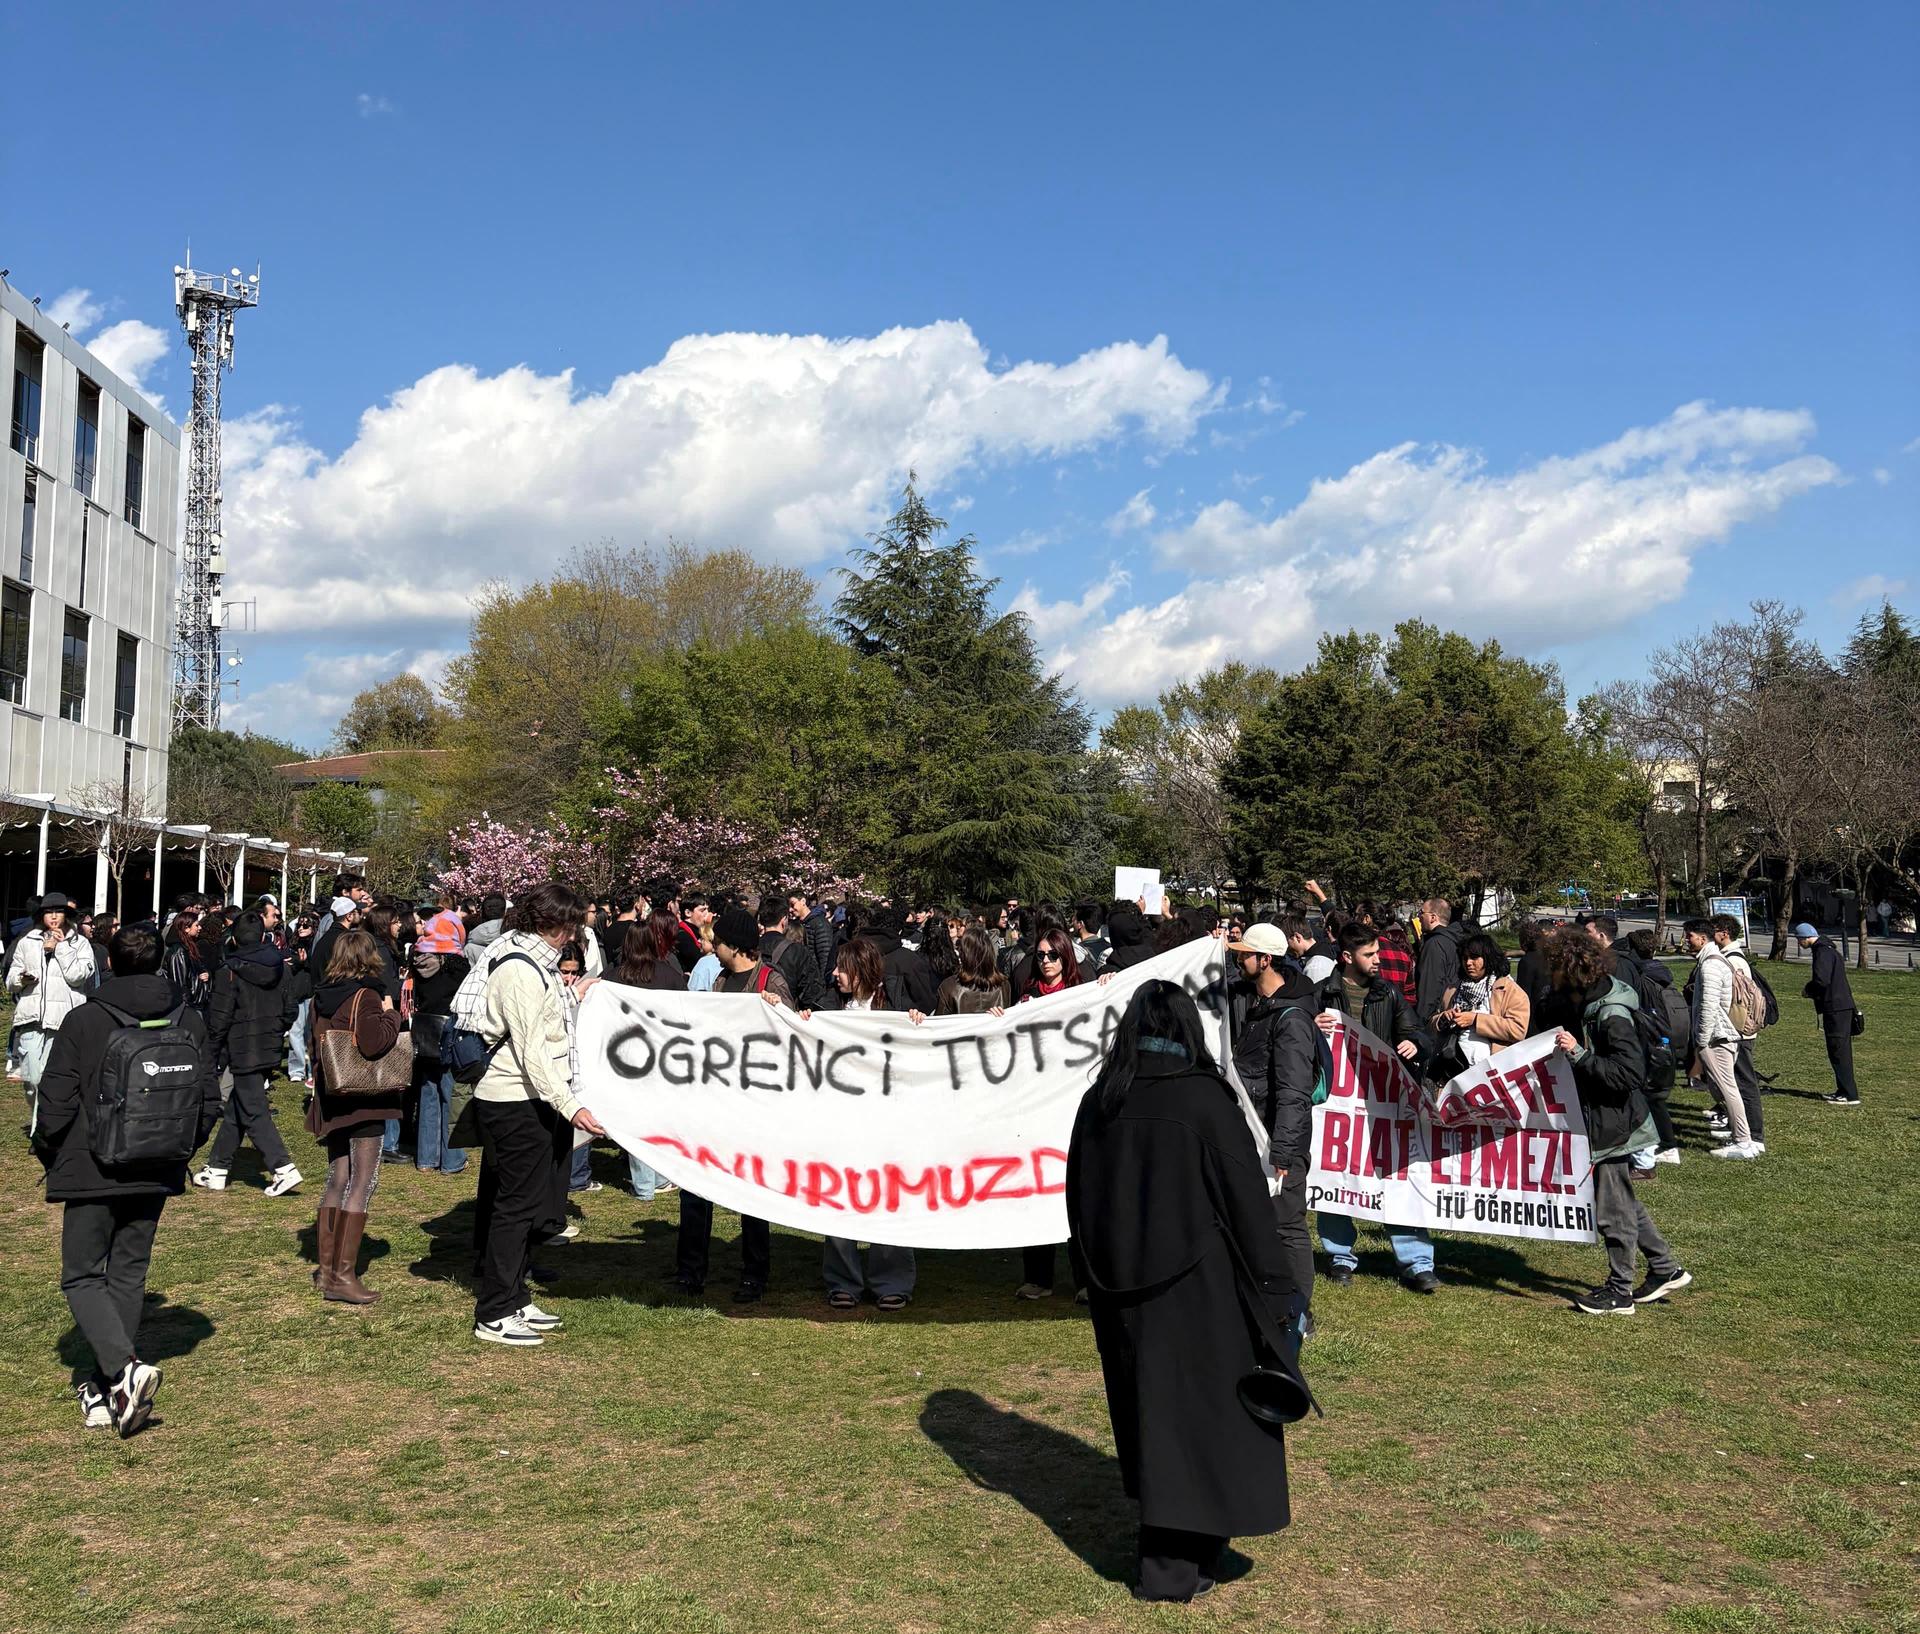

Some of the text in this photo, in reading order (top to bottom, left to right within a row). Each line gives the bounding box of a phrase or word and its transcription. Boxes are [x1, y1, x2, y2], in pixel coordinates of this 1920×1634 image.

[606, 1000, 893, 1095] ÖĞRENCİ
[1320, 1106, 1415, 1181] BİAT
[1431, 1122, 1576, 1196] ETMEZ!
[1436, 1190, 1466, 1220] İTÜ
[1474, 1193, 1594, 1232] ÖĞRENCİLERİ
